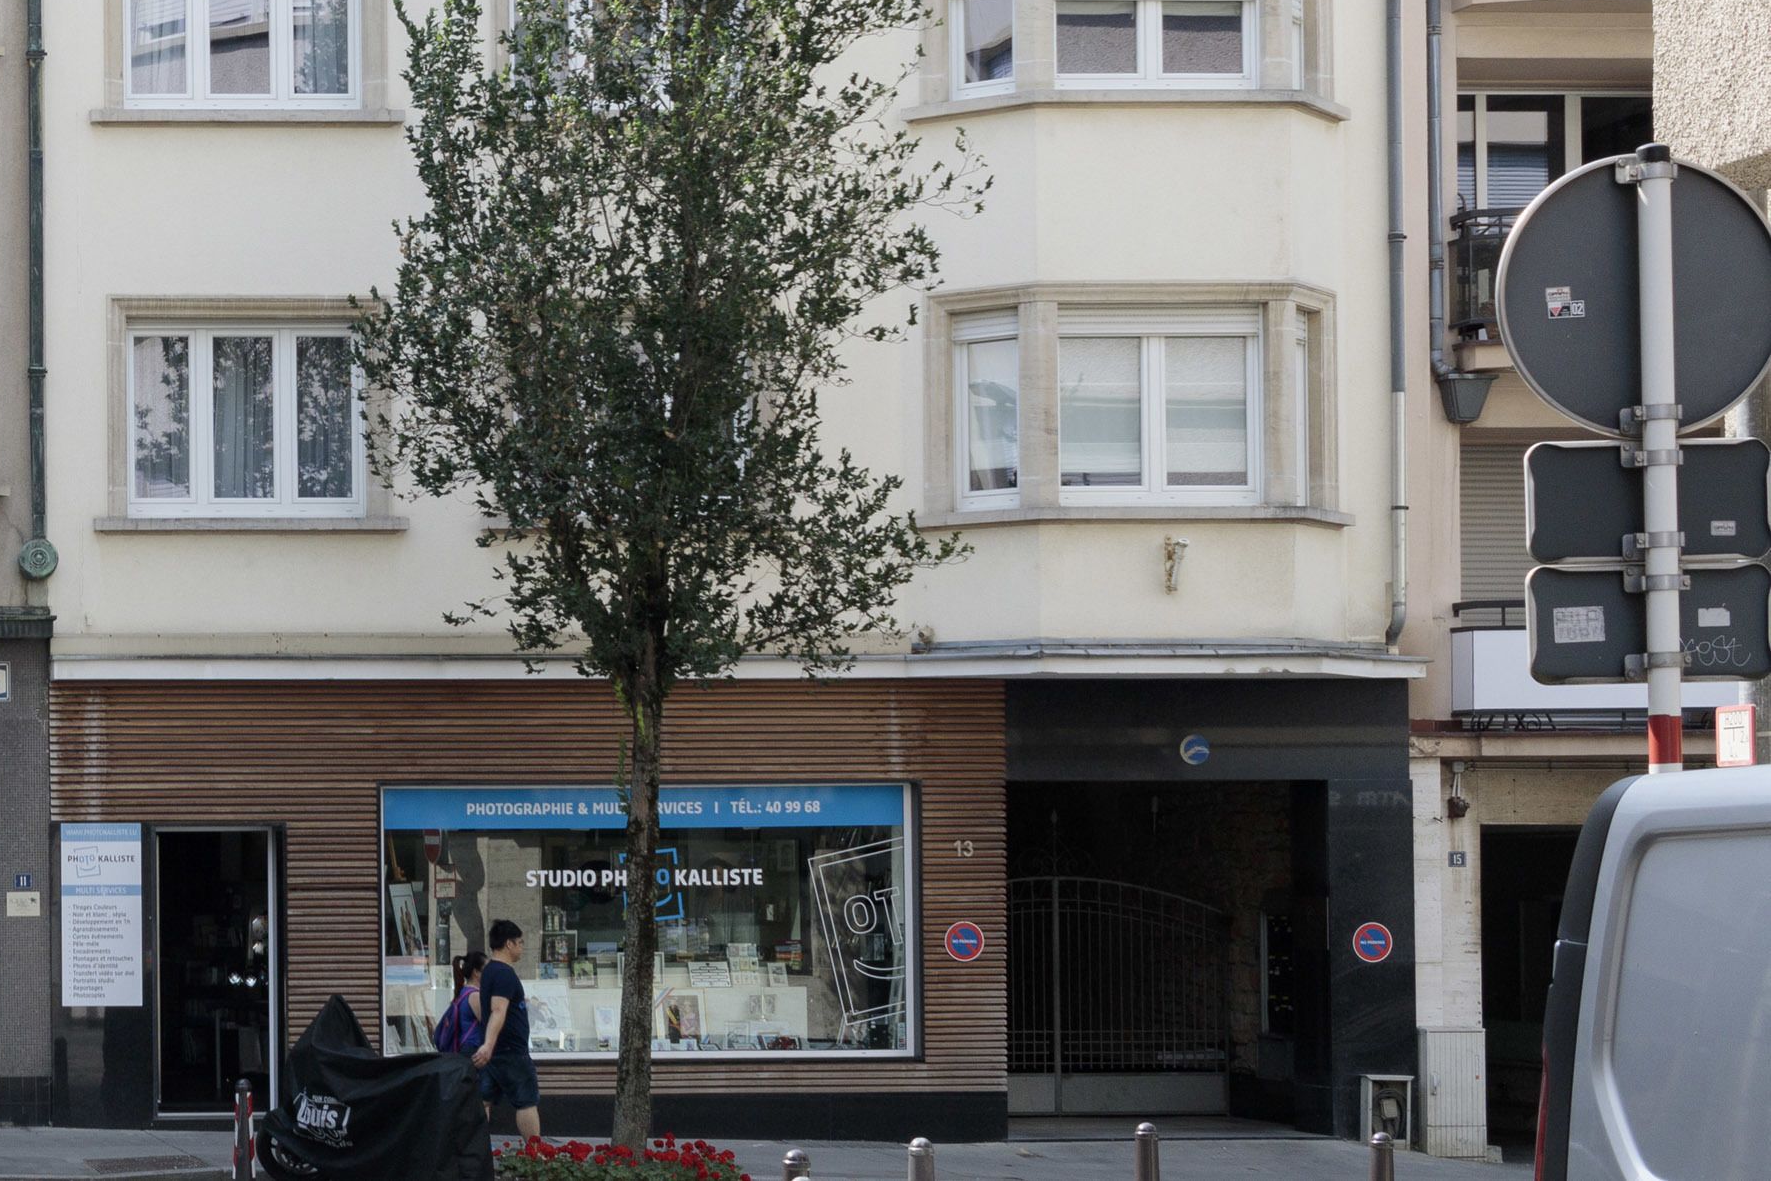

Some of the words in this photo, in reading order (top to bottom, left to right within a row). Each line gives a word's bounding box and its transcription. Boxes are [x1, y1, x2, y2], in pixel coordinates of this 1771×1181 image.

[466, 802, 573, 816] PHOTOGRAPHIE
[578, 802, 589, 815] &
[765, 801, 782, 814] 40
[785, 801, 802, 814] 99
[804, 801, 821, 814] 68
[953, 840, 974, 857] 13
[68, 854, 95, 866] PHOTO
[97, 854, 135, 863] KALLISTE
[1453, 853, 1462, 865] 15
[20, 875, 27, 887] 11
[525, 869, 597, 888] STUDIO
[601, 868, 670, 887] PHO
[674, 867, 764, 887] KALLISTE
